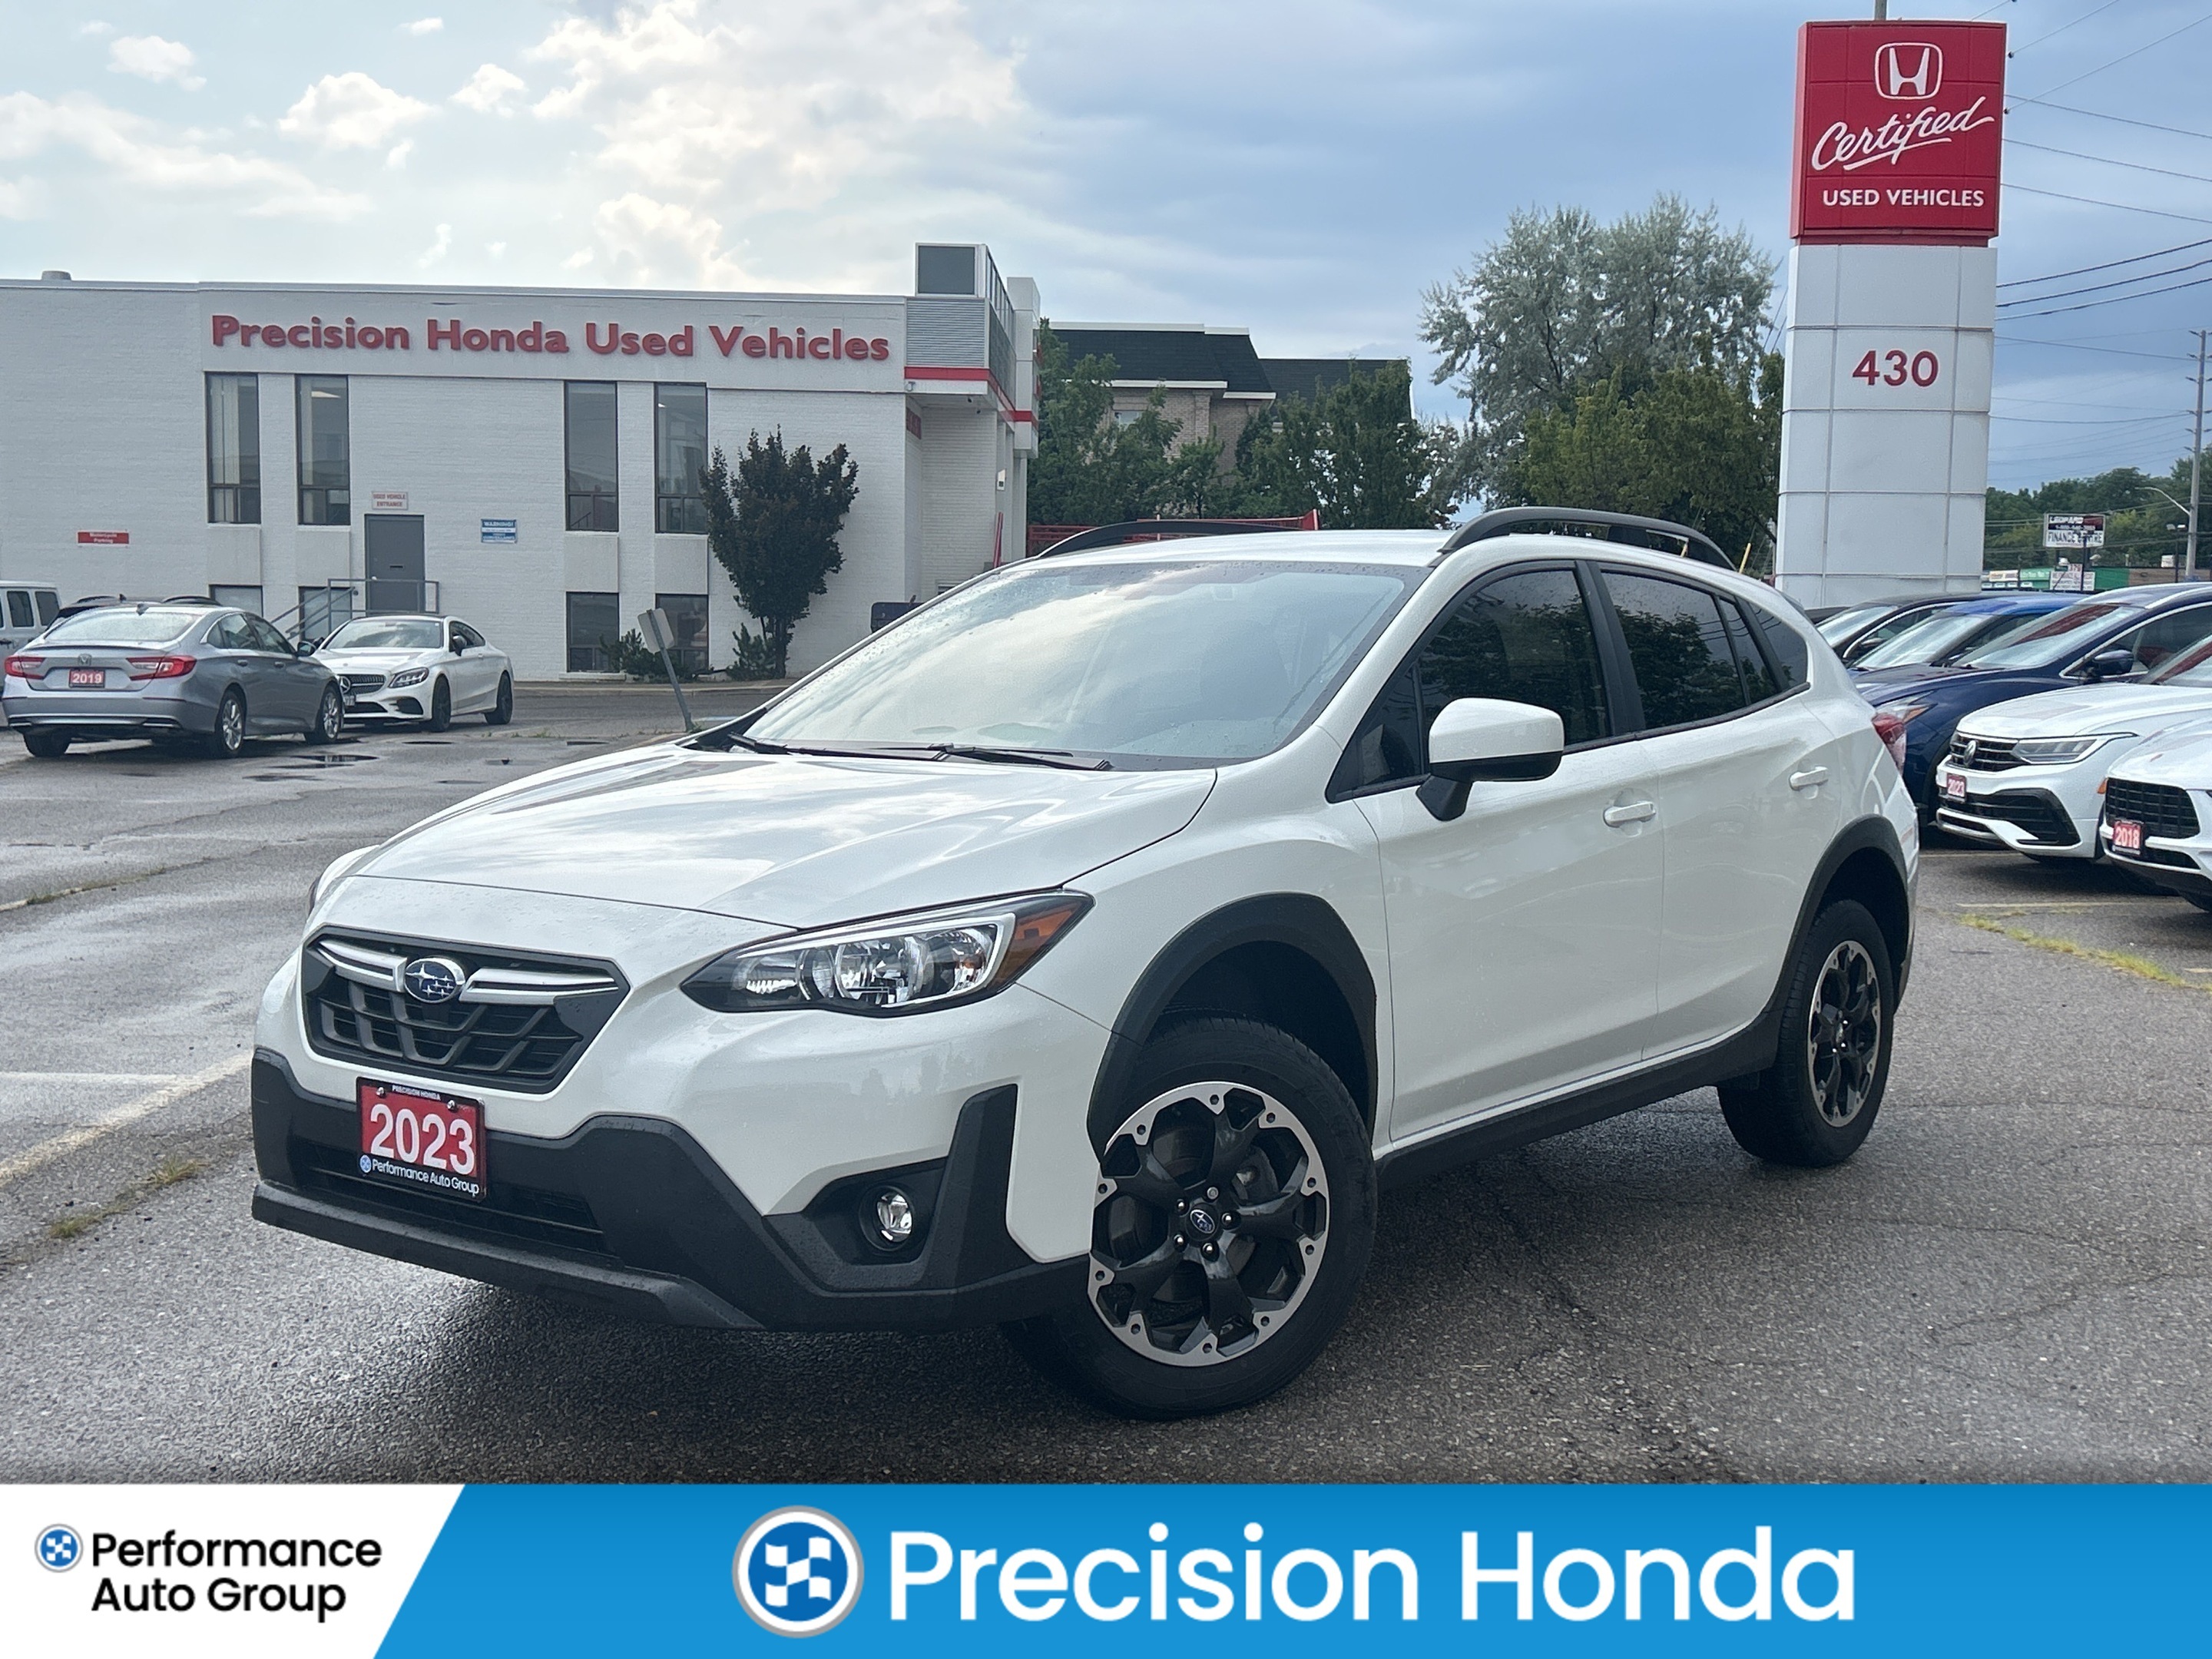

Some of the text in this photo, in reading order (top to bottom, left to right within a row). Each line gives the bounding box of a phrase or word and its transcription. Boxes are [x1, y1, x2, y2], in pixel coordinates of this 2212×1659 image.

[1811, 95, 1995, 171] Certified
[1823, 189, 1985, 208] USED VEHICLES
[212, 315, 889, 361] Precision Honda Used Vehicles
[1853, 350, 1939, 387] 430
[72, 673, 102, 684] 2019
[2114, 826, 2140, 849] 2018
[370, 1104, 475, 1175] 2023
[372, 1158, 480, 1197] Performance Auto Group
